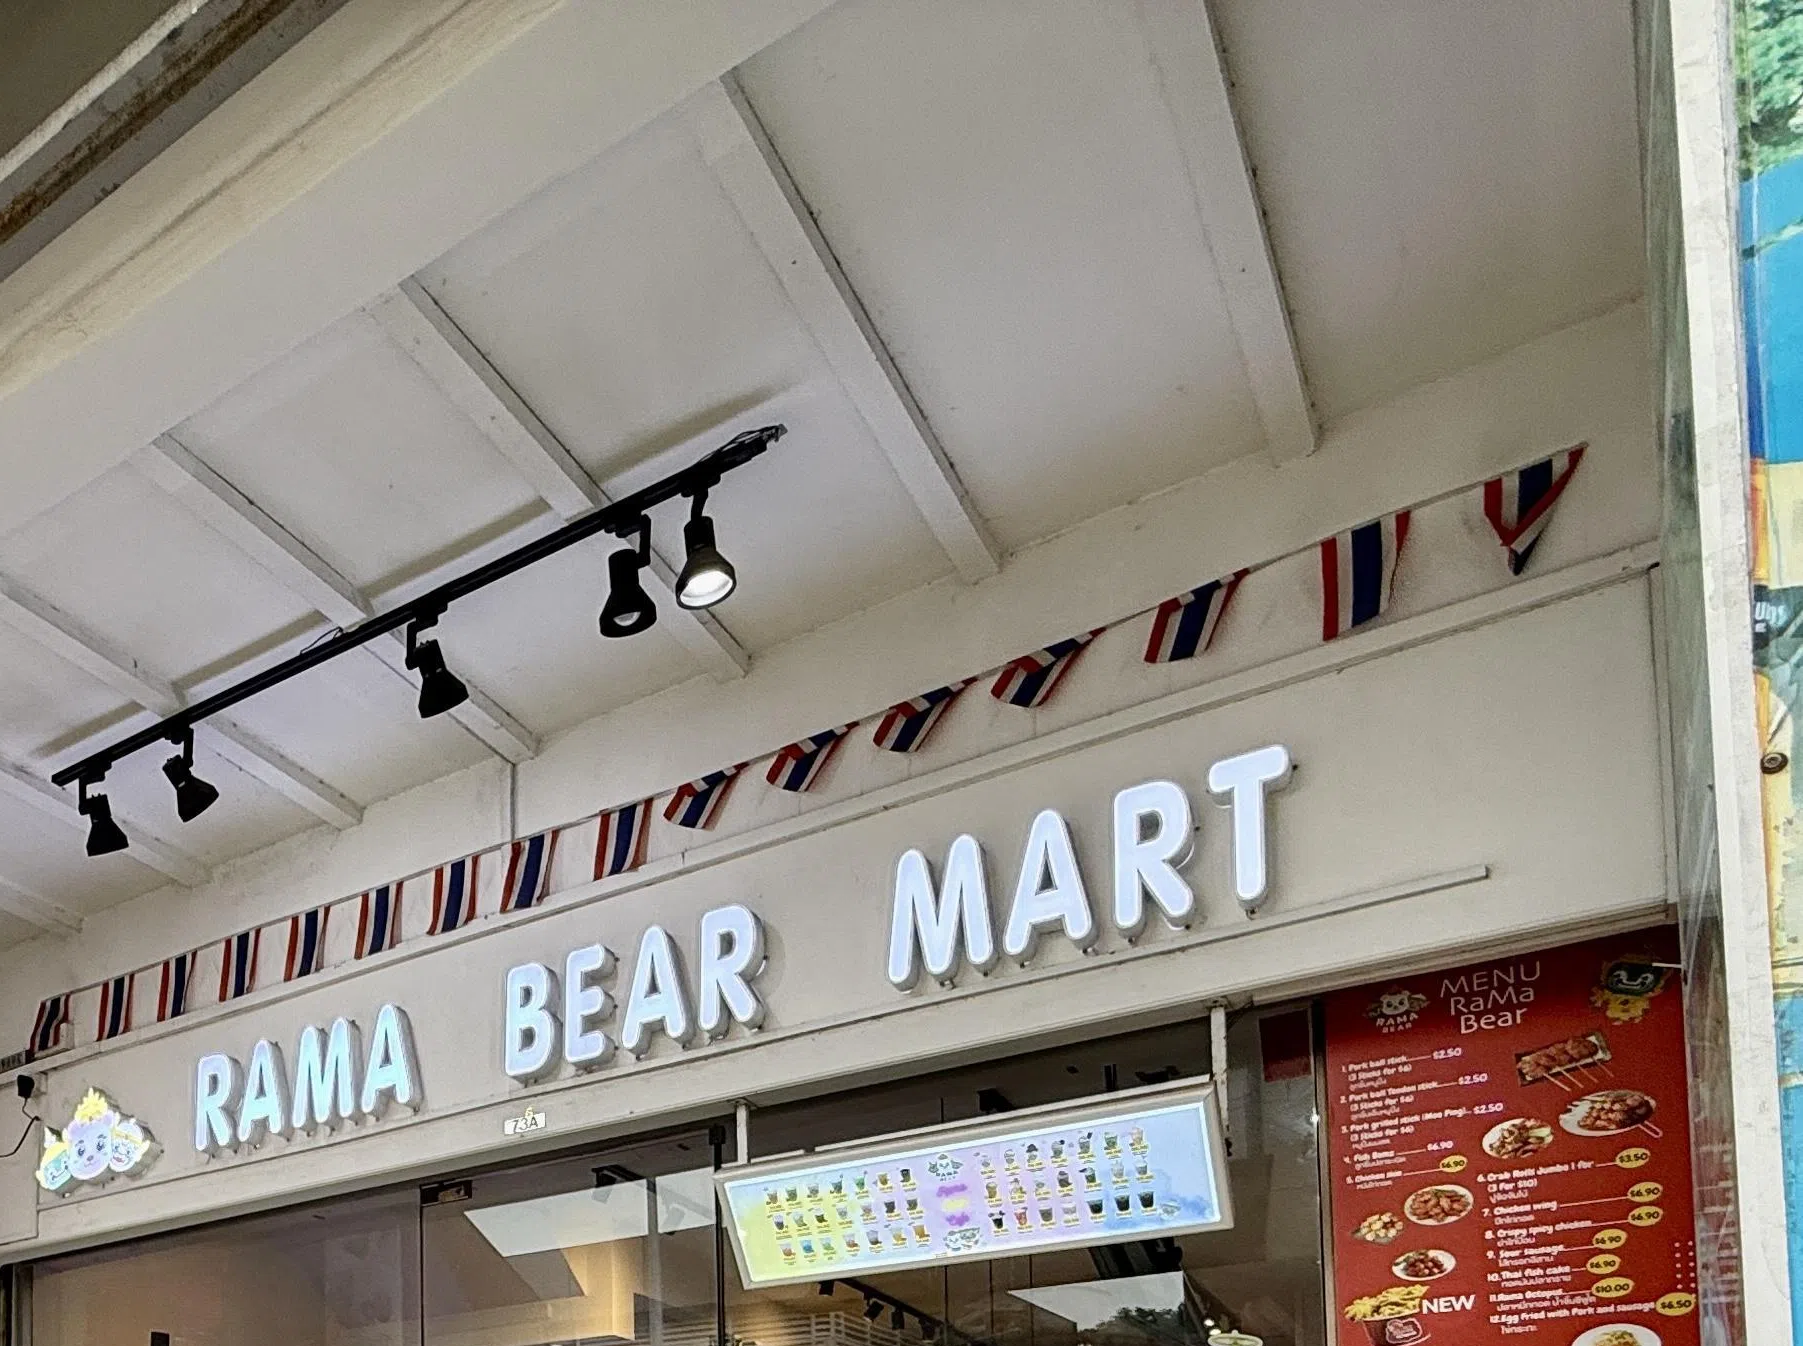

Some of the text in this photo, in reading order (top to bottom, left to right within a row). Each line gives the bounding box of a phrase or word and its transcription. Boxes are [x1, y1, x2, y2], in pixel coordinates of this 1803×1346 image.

[195, 744, 1292, 1152] RAMA BEAR MART
[1440, 961, 1540, 998] MENU
[1450, 986, 1535, 1016] RaMa
[1376, 1013, 1419, 1026] RAMA
[1382, 1023, 1412, 1033] BEAR
[1460, 1008, 1528, 1034] Bear
[1348, 1062, 1369, 1071] Pork
[1433, 1048, 1462, 1060] $2.50
[1458, 1073, 1488, 1085] $2.50
[1473, 1103, 1504, 1115] $2.50
[512, 1116, 539, 1135] 73A
[1427, 1140, 1454, 1151] $6.90
[1442, 1159, 1465, 1169] $6.90
[1618, 1152, 1649, 1163] $3.50
[1533, 1201, 1557, 1211] wing
[1630, 1187, 1661, 1197] $6.90
[1631, 1211, 1660, 1221] $6.90
[1524, 1268, 1544, 1277] fish
[1590, 1260, 1616, 1269] $6.90
[1596, 1283, 1630, 1293] $10.00
[1422, 1294, 1476, 1315] NEW
[1547, 1308, 1570, 1318] with
[1571, 1306, 1595, 1316] Pork
[1596, 1303, 1614, 1313] and
[1660, 1299, 1692, 1310] $6.50
